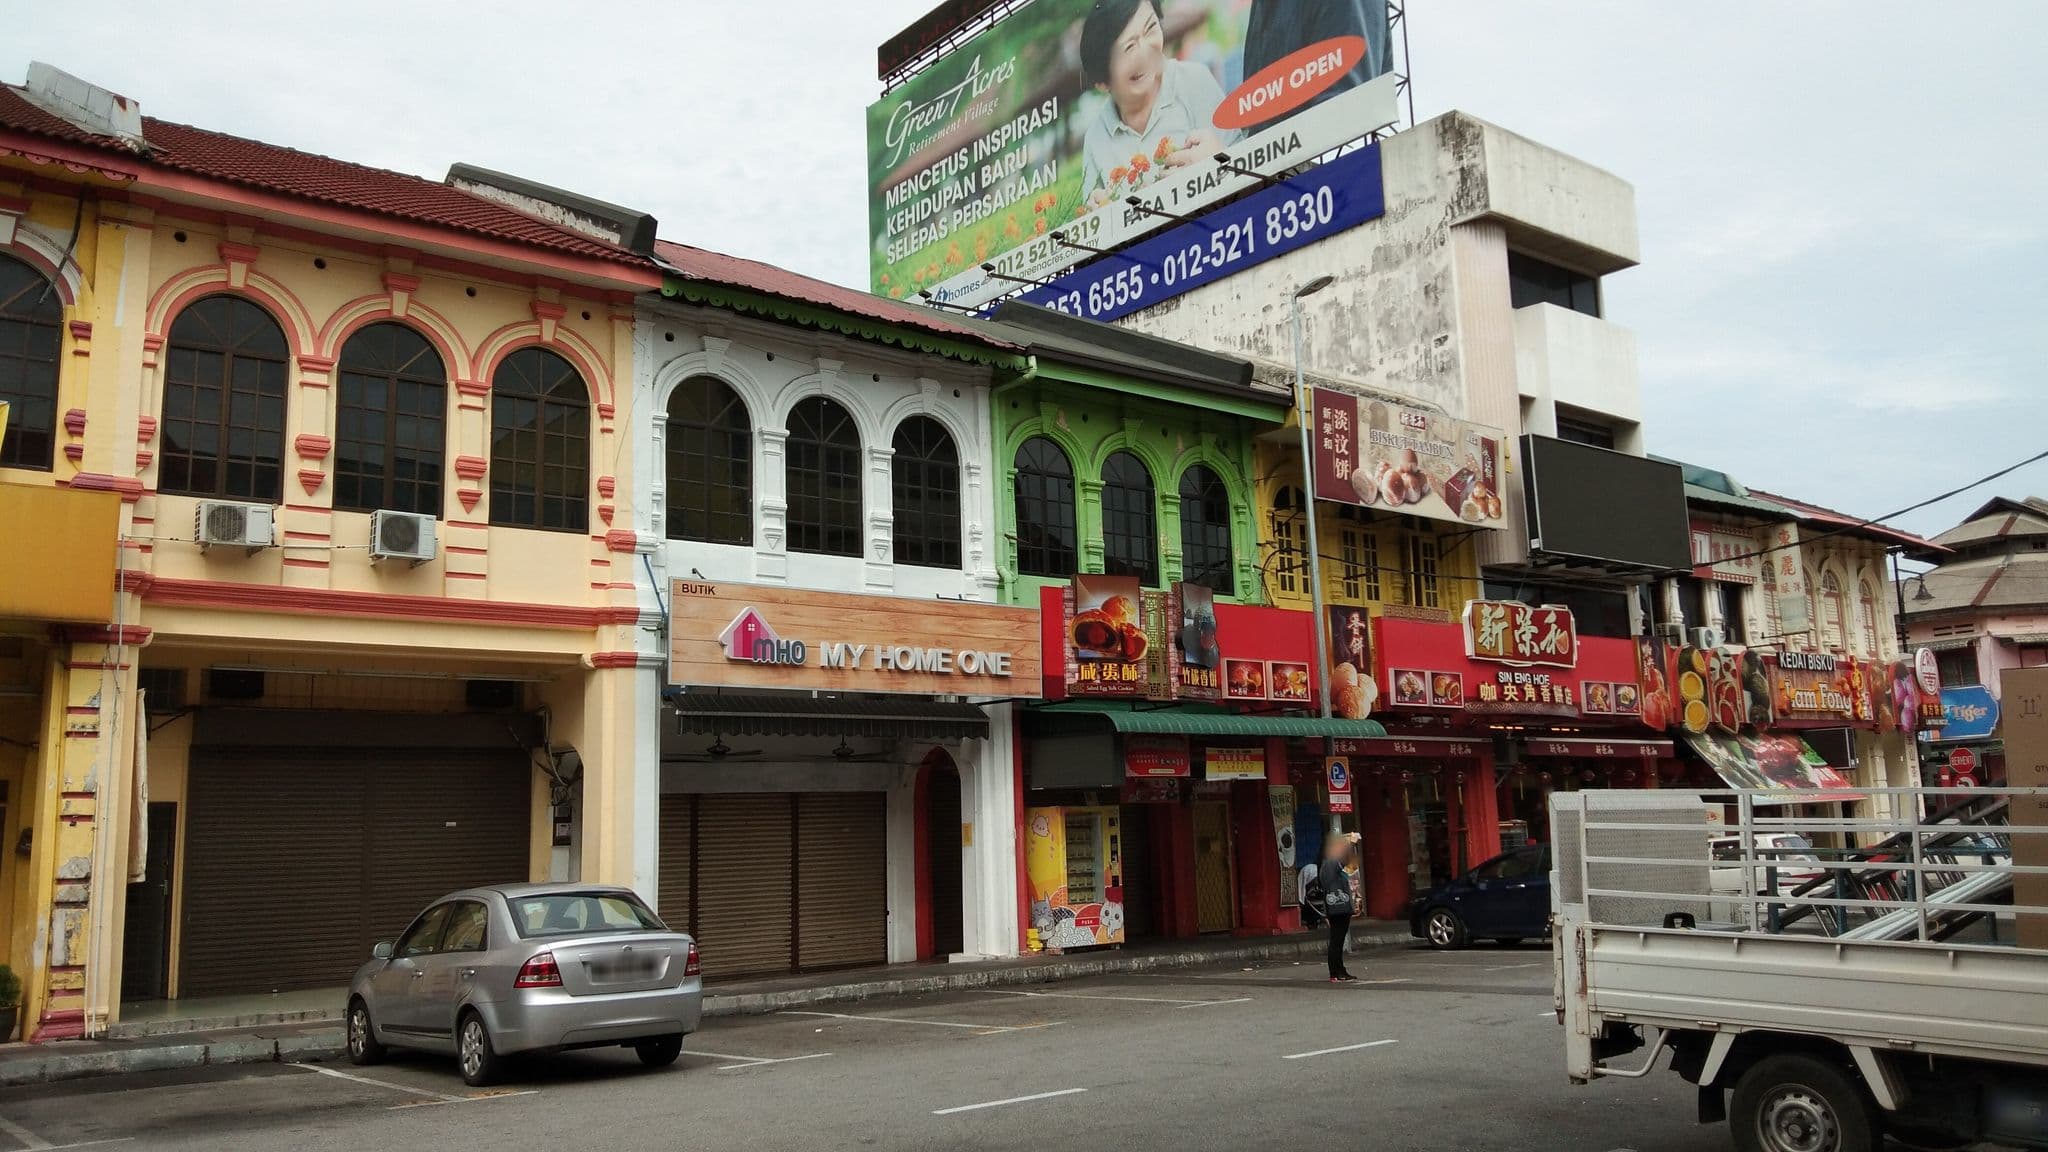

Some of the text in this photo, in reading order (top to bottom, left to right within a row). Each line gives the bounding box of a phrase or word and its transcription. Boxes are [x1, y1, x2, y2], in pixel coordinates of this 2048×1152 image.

[886, 54, 1016, 168] Green Acres
[1238, 48, 1343, 117] NOW OPEN
[886, 97, 1058, 210] MENCETUS INSPIRASI
[908, 97, 1000, 157] Retirement Village
[887, 145, 1028, 238] KEHIDUPAN BARU
[1171, 187, 1179, 206] 1
[1233, 131, 1303, 178] DIBINA
[887, 160, 1058, 265] SELEPAS PERSARAAN
[997, 251, 1025, 276] 012
[1028, 238, 1056, 264] 521
[1088, 264, 1144, 316] 6555
[1163, 217, 1255, 287] 012-521
[1265, 185, 1334, 246] 8330
[681, 583, 716, 596] BUTIK
[819, 641, 1013, 678] MY HOME ONE
[1498, 672, 1550, 686] SIN ENG HOE
[1779, 652, 1838, 671] KEDAI BISKUT
[1784, 679, 1818, 709] Lam
[1818, 682, 1853, 716] Fong
[1951, 704, 1988, 722] Tiger
